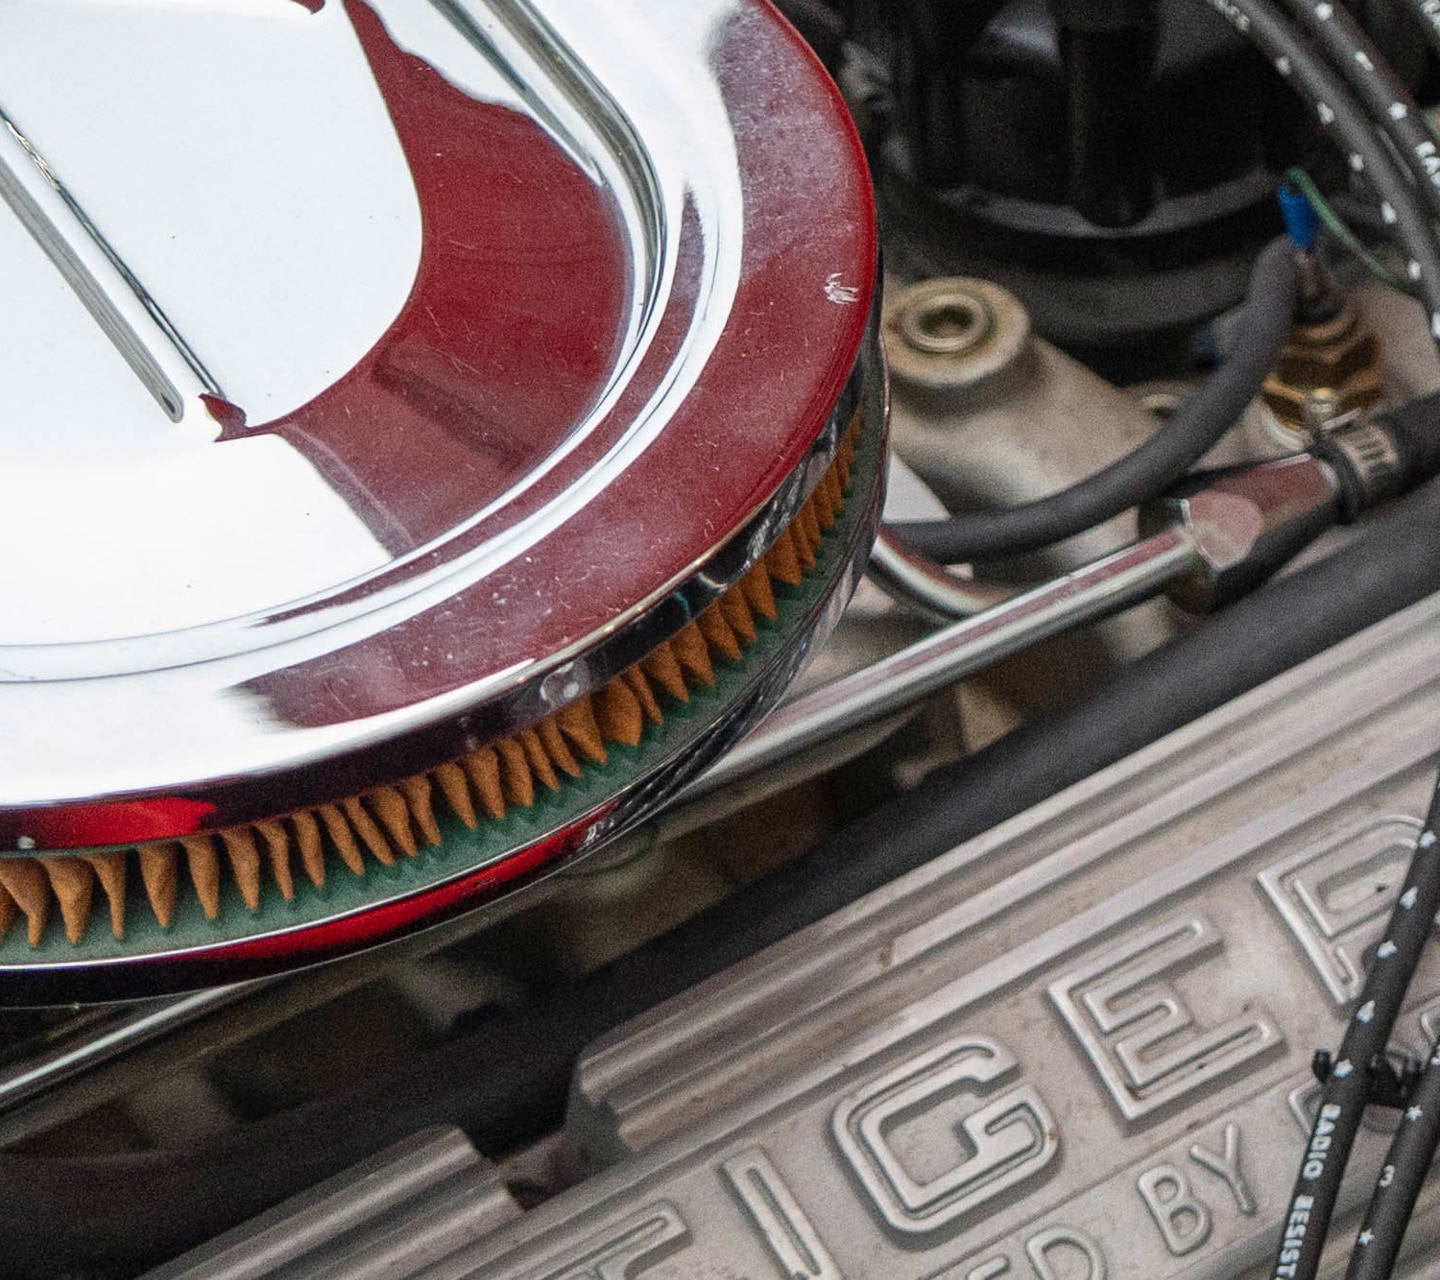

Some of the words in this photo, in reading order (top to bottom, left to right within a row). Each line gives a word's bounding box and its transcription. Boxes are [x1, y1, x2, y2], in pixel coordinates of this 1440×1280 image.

[1301, 1103, 1342, 1181] RADIO
[1378, 1164, 1396, 1188] 3
[1137, 1122, 1257, 1257] BY
